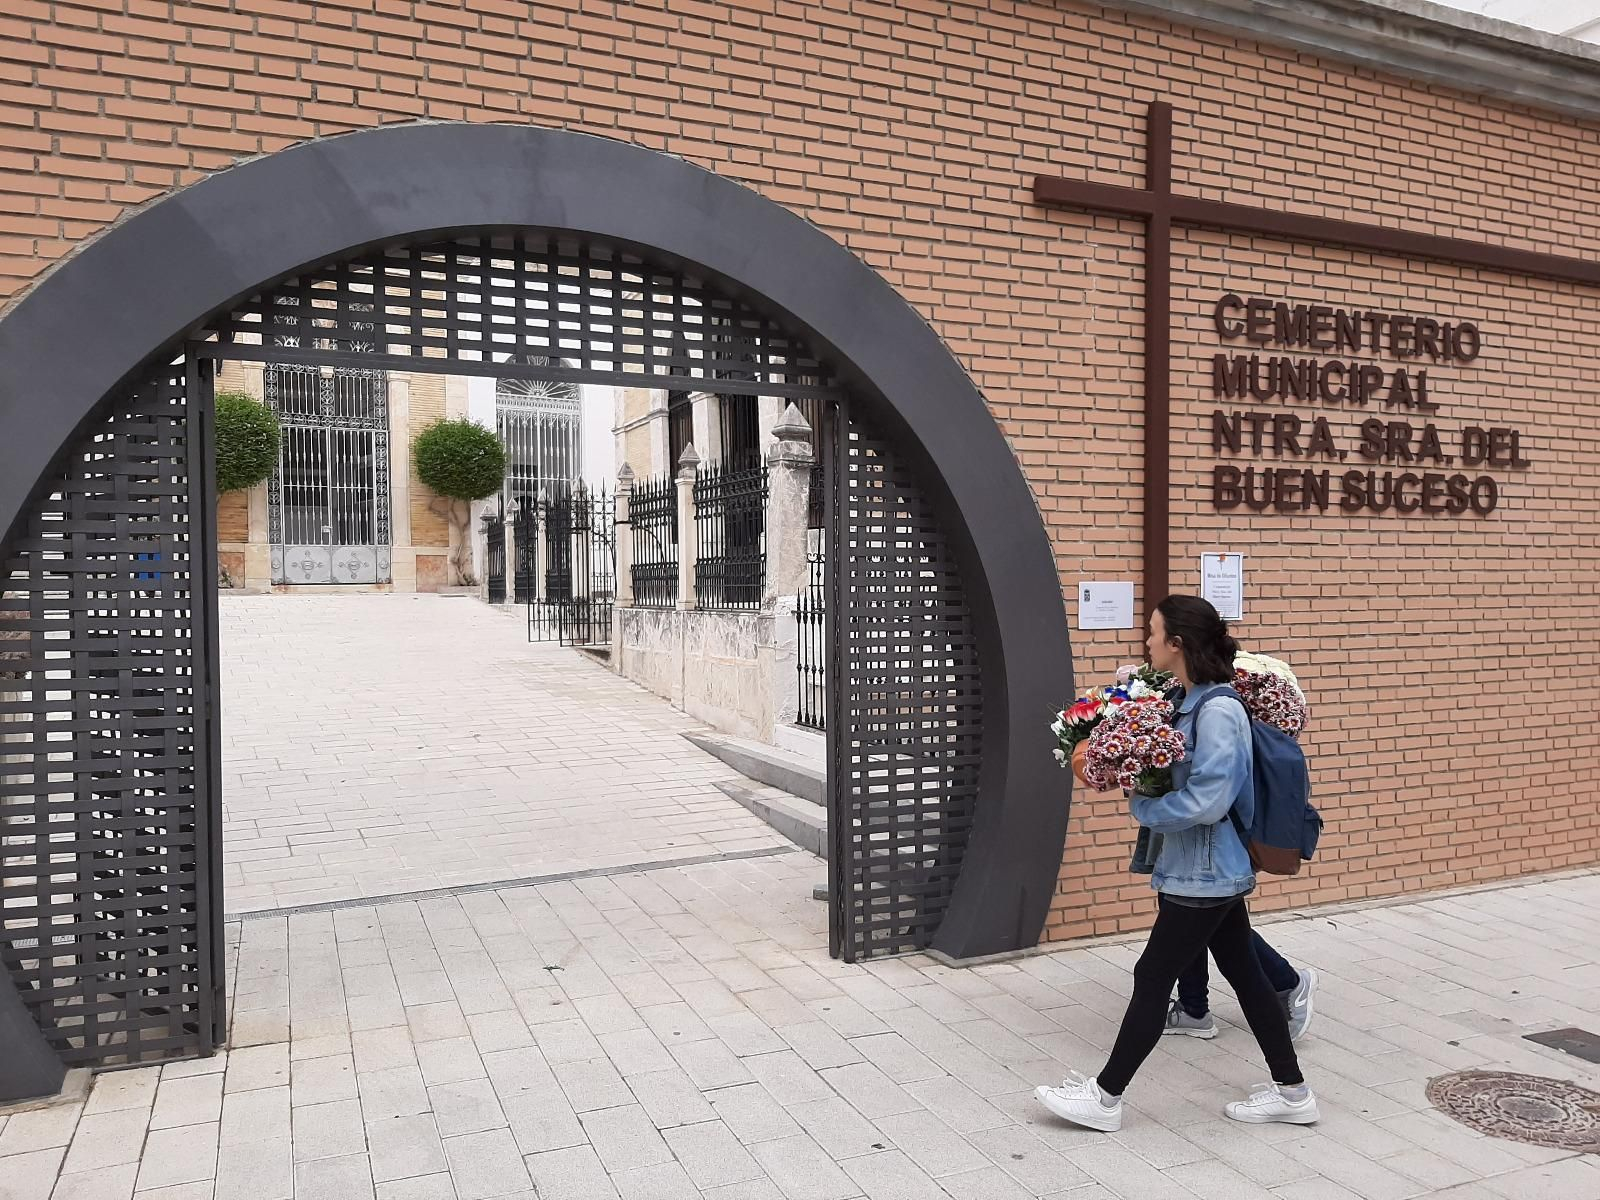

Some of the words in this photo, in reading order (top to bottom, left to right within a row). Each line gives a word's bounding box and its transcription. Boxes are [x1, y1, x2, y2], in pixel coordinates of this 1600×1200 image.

[1214, 293, 1480, 362] CEMENTERIO
[1213, 353, 1439, 410] MUNICIPAL
[1212, 410, 1348, 460] NTRA.
[1360, 418, 1454, 464] SRA.
[1463, 425, 1532, 467] DEL
[1213, 465, 1330, 510] BUEN
[1341, 470, 1498, 514] SUCESO
